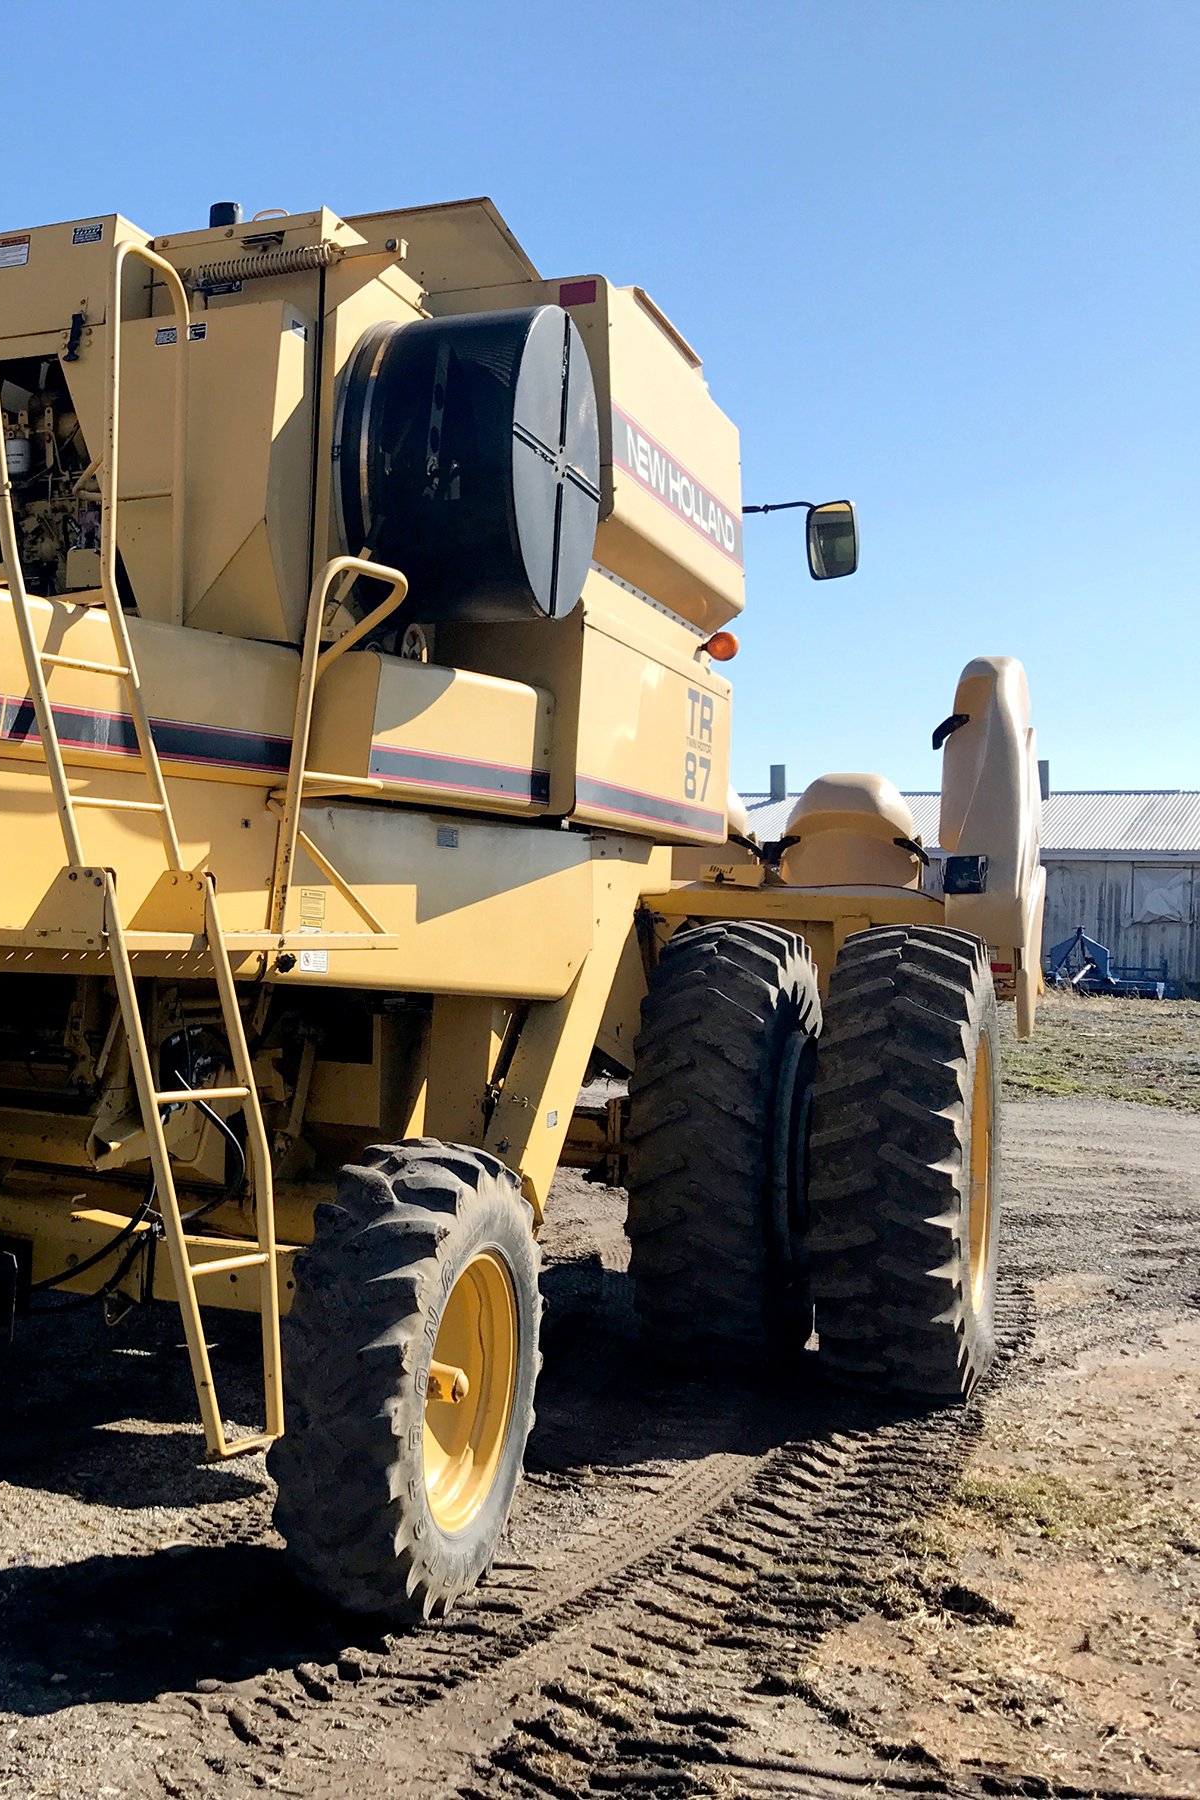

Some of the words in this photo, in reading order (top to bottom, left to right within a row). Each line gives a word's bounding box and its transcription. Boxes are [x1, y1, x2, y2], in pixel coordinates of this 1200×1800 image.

[626, 424, 666, 495] NEW
[668, 462, 735, 553] HOLLAND
[687, 687, 714, 743] TR
[684, 751, 712, 802] 87
